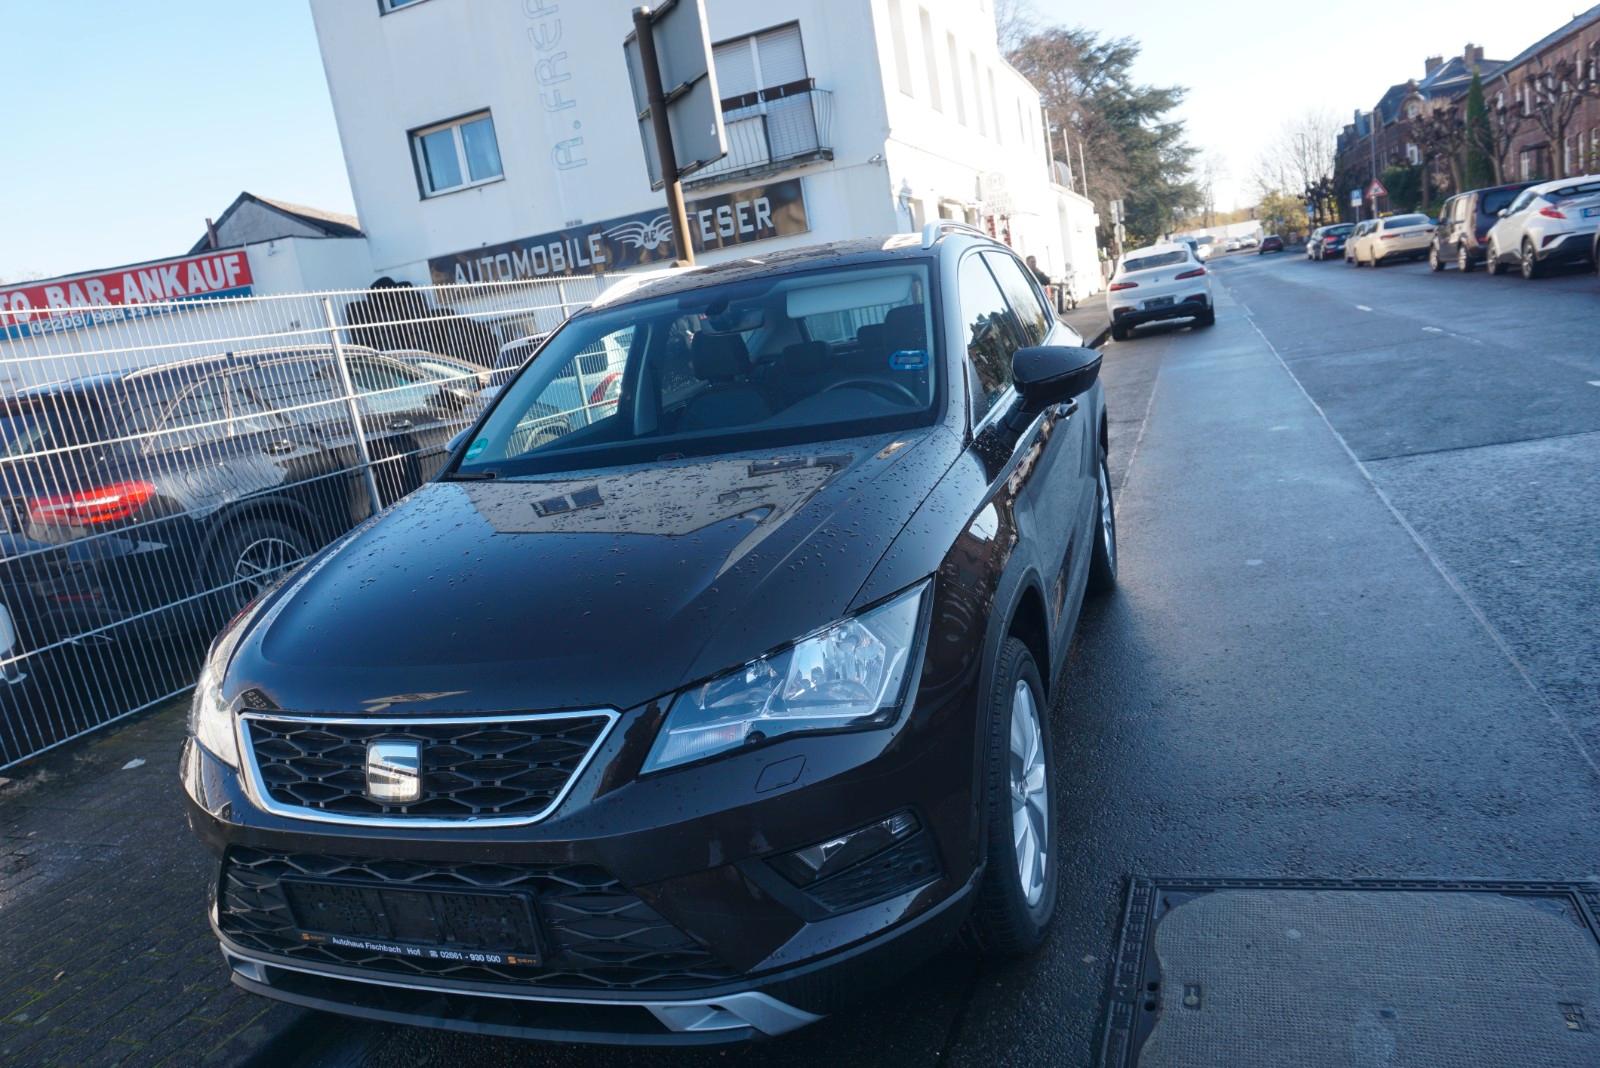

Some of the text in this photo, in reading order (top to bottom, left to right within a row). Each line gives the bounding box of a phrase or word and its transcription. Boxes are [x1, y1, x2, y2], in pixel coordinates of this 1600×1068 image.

[453, 197, 774, 284] AUTOMOBILE ESER
[44, 255, 241, 317] BAR-ANKAUF
[332, 936, 364, 950] Autohaus
[365, 941, 402, 955] Fischbach
